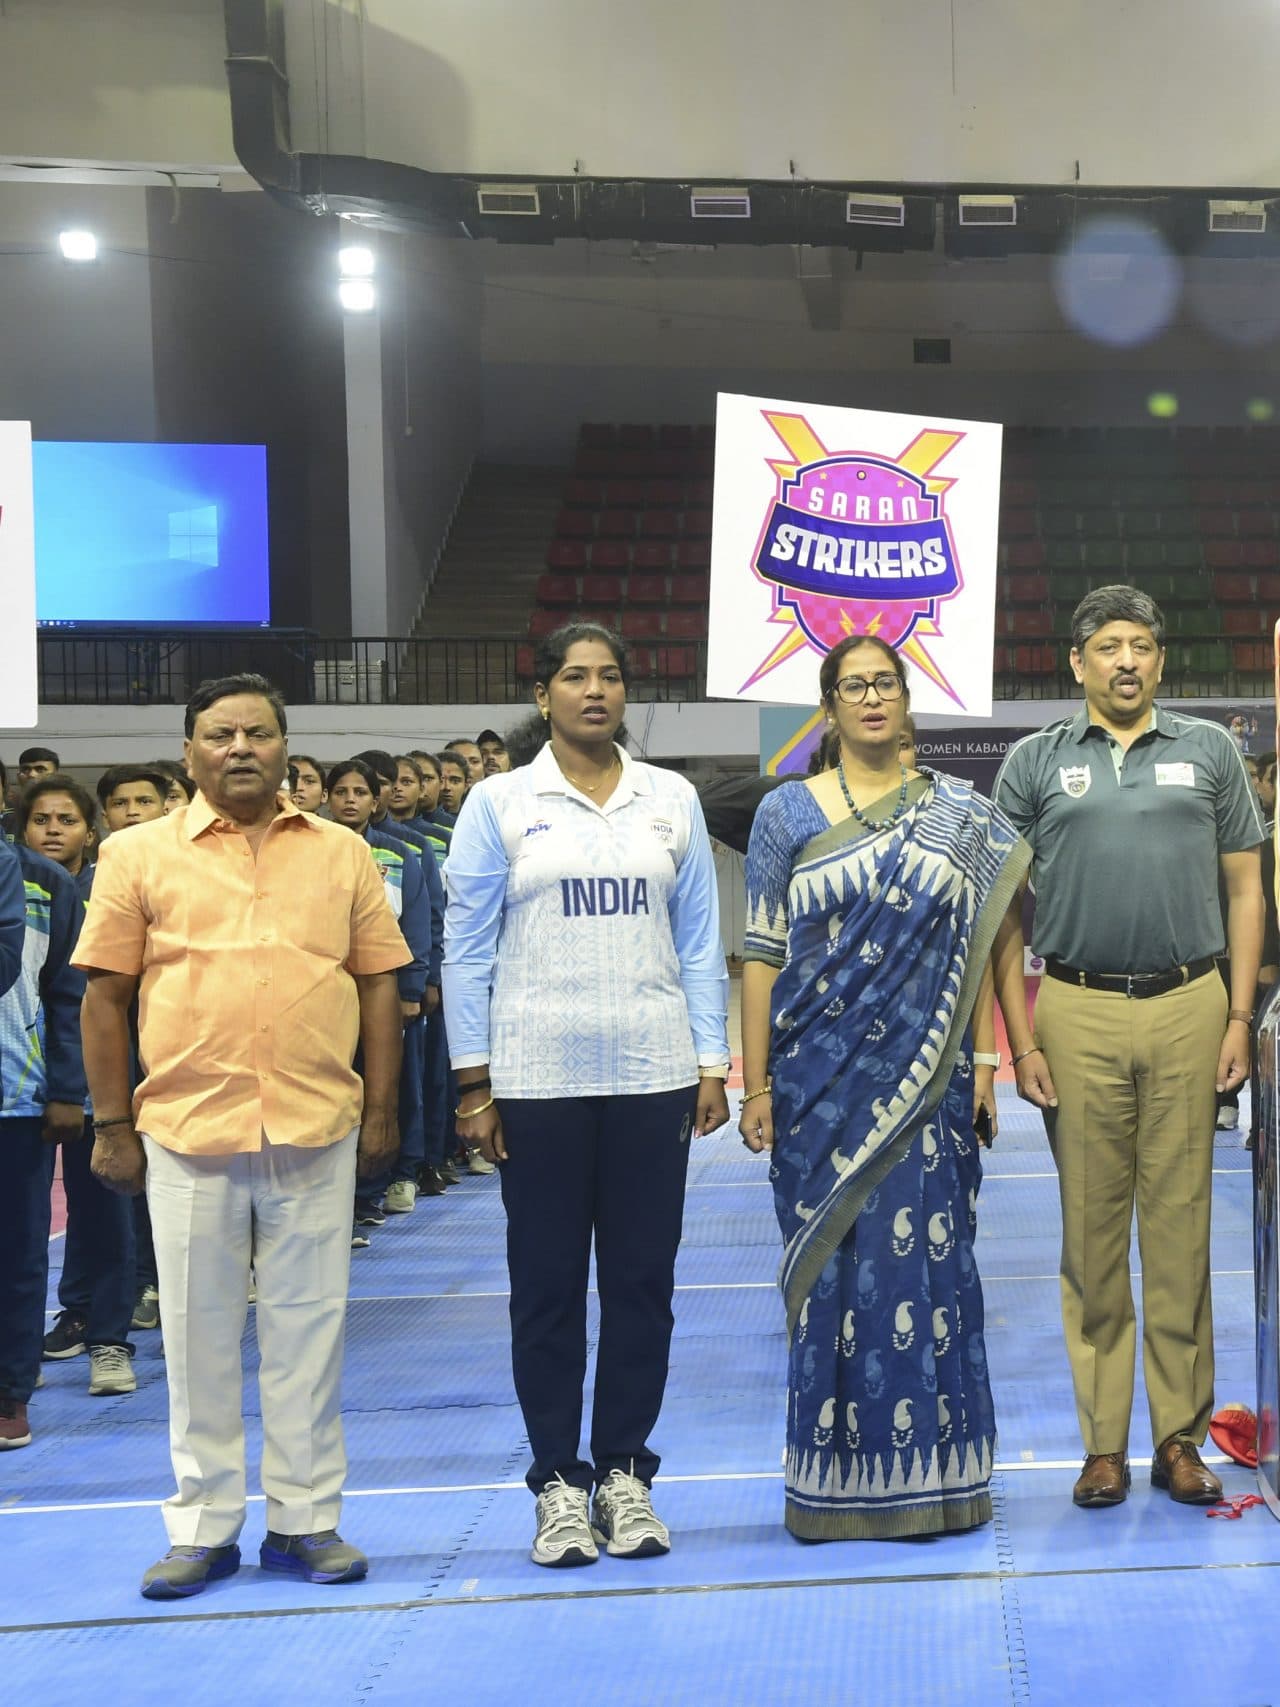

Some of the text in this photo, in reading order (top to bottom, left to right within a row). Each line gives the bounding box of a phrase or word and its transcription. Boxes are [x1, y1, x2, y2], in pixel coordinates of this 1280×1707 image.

[808, 487, 919, 521] SARAN
[770, 523, 947, 579] STRIKERS
[966, 742, 1014, 754] KABAD
[650, 824, 674, 836] INDIA
[560, 877, 650, 917] INDIA
